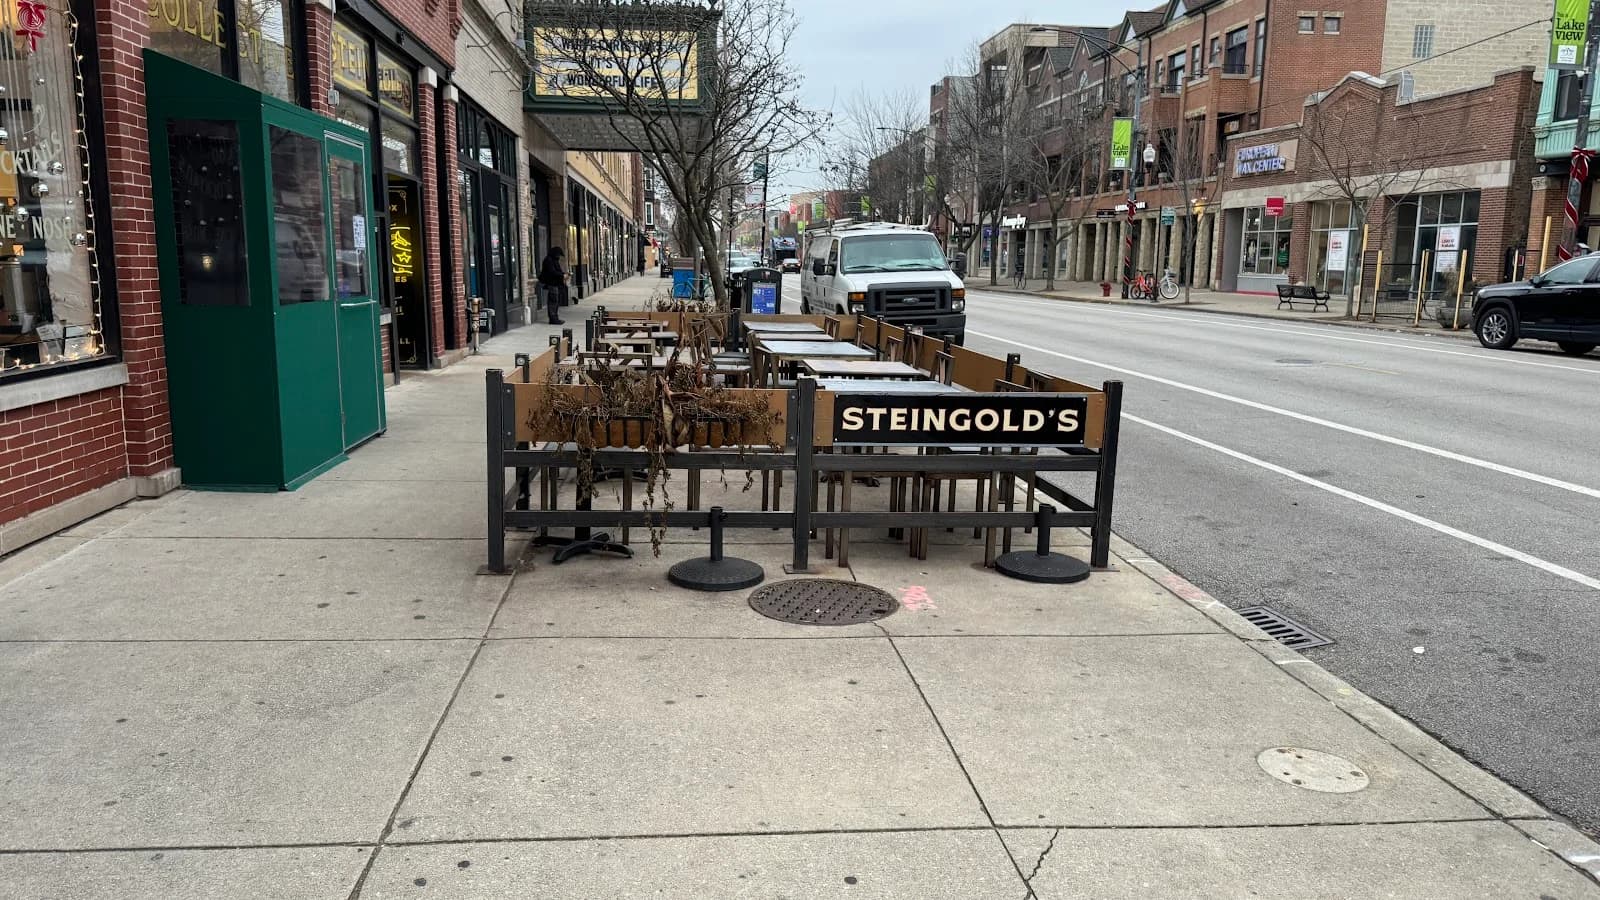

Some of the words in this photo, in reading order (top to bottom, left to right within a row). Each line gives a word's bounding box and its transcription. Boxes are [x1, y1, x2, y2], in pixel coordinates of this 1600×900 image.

[1555, 18, 1585, 30] Lake
[1555, 30, 1584, 40] view
[567, 73, 631, 87] WONDERFU
[634, 75, 658, 88] LIFE
[1253, 157, 1286, 173] CENTER
[32, 216, 73, 251] NOSH
[841, 407, 1079, 432] STEINGOLD'S
